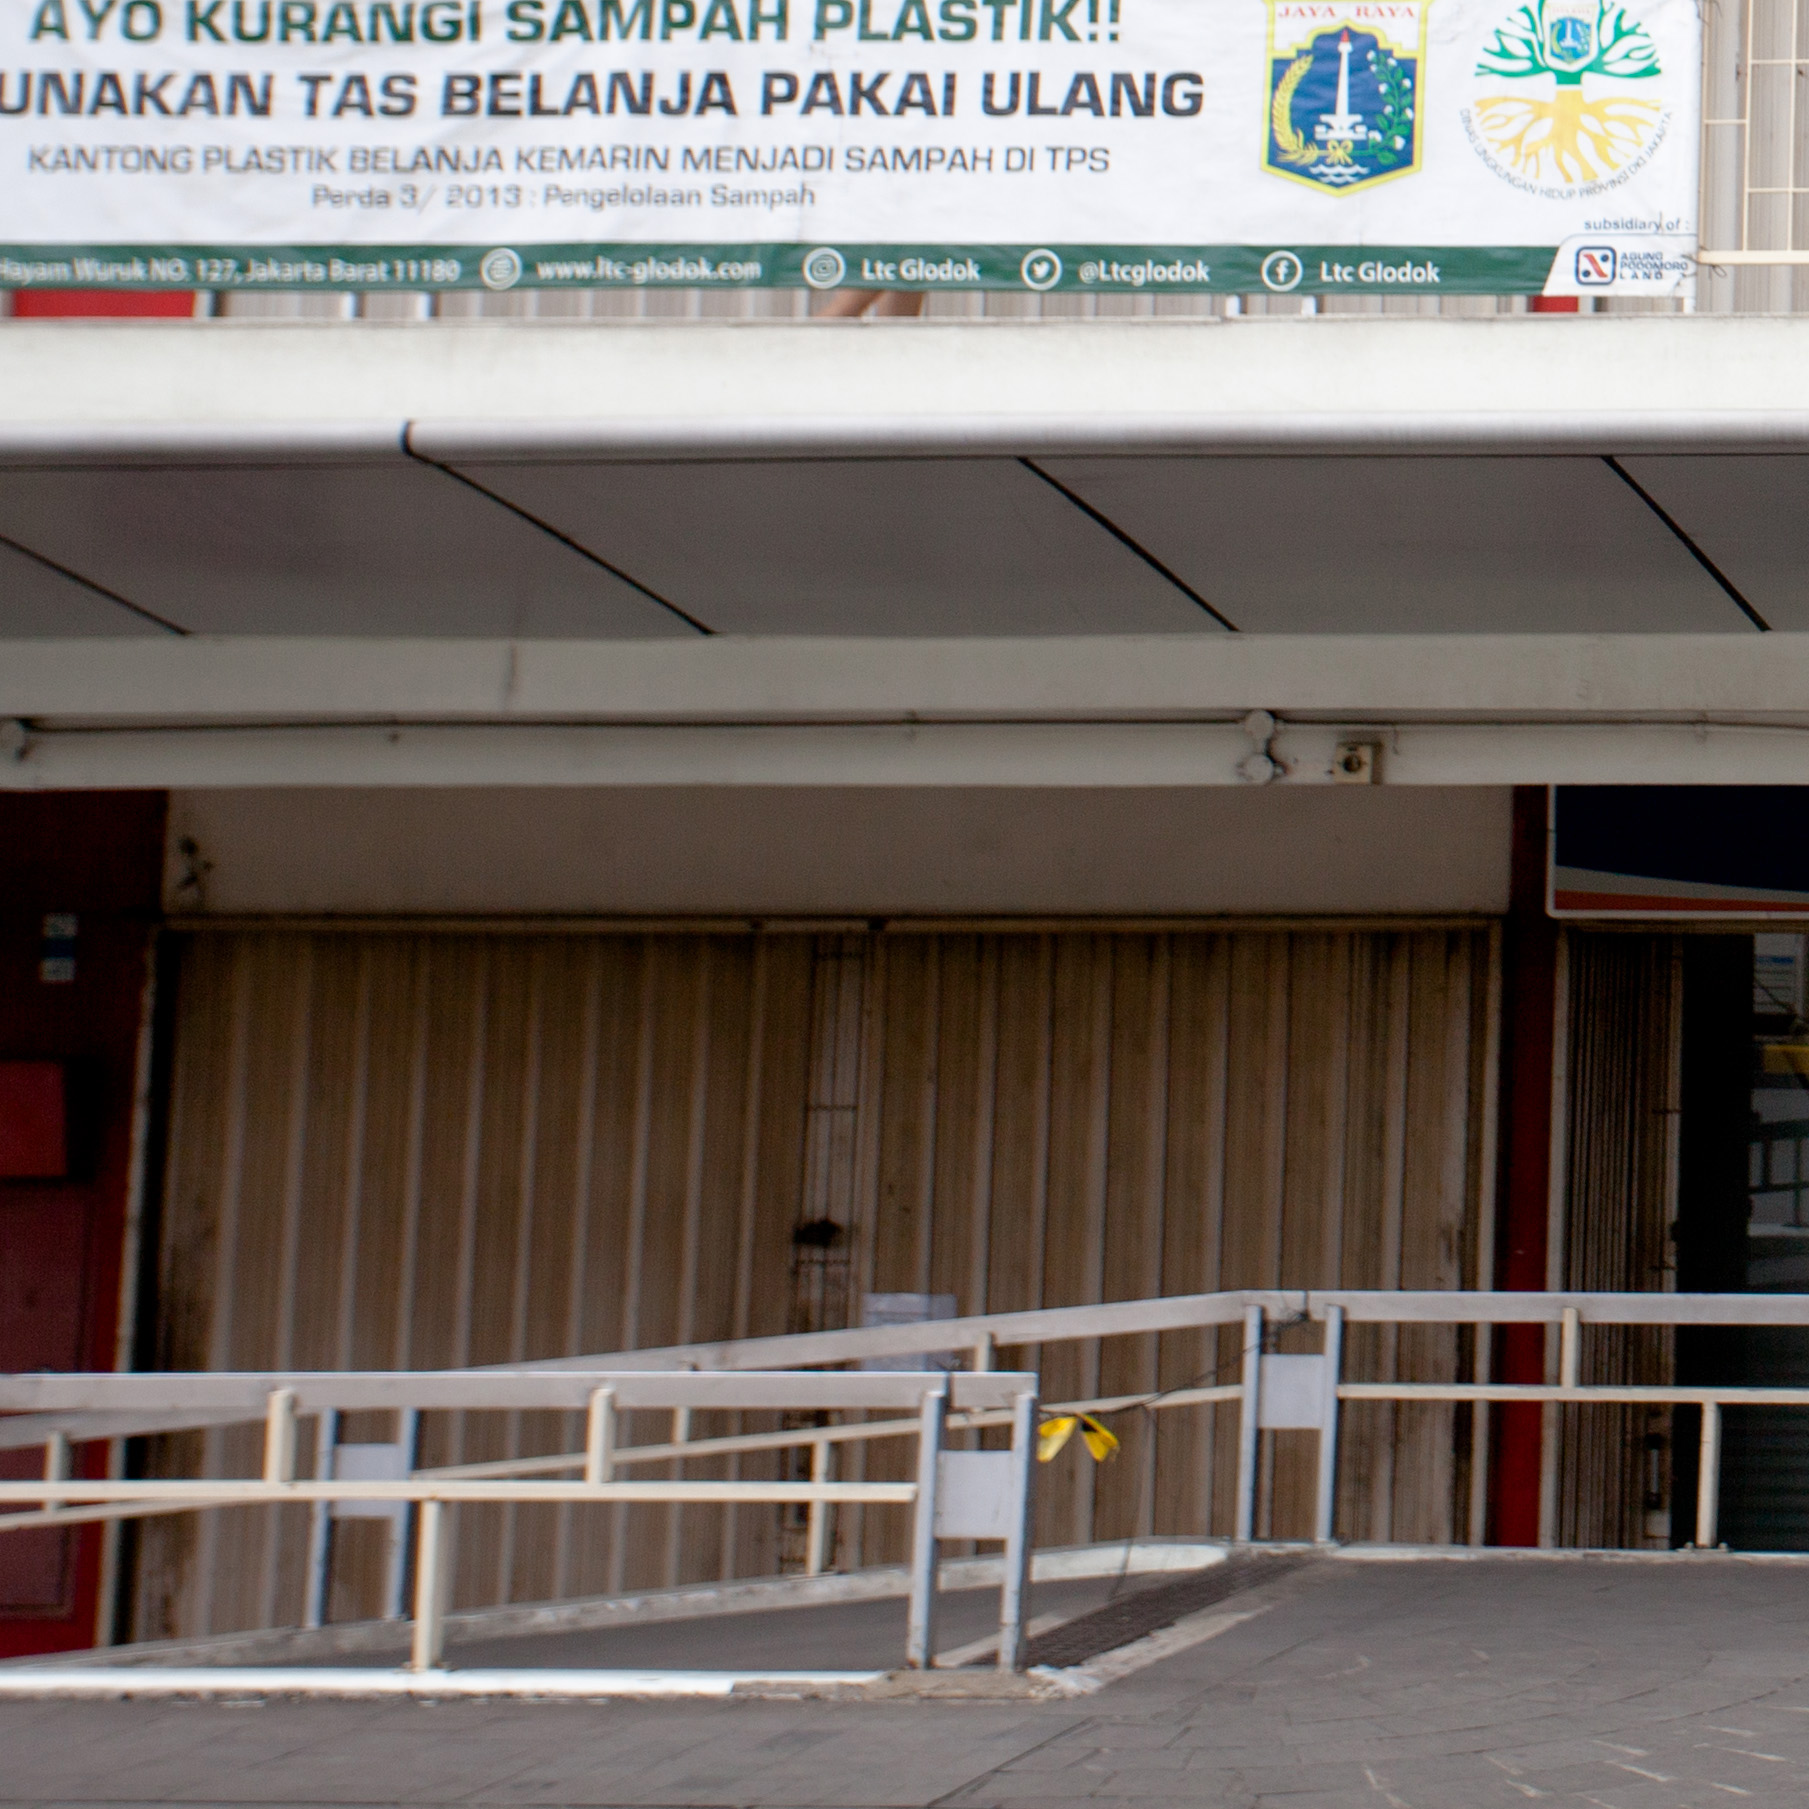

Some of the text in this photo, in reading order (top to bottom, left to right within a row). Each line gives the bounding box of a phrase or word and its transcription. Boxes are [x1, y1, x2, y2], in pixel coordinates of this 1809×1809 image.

[1278, 5, 1415, 18] JAYA RAYA
[0, 71, 1205, 118] UNAKAN TAS BELANJA PAKAI ULANG
[28, 144, 1110, 174] KANTONG PLASTIK BELANJA KEMARIN MENJADI SAMPAH DI TPS
[313, 185, 390, 208] Perda
[446, 185, 521, 208] 2013
[543, 185, 702, 212] Pengelolaan
[711, 185, 815, 211] Sampah
[1539, 186, 1577, 201] HIDUP
[1579, 171, 1630, 199] PROVINSI
[1584, 217, 1661, 235] subsidiary
[1665, 217, 1682, 231] of
[1620, 251, 1664, 261] AGUNG
[1620, 260, 1689, 272] PODOMORO
[72, 257, 147, 282] Wuruk
[246, 257, 327, 282] Jakarta
[330, 258, 390, 282] Barat
[392, 258, 462, 282] 11180
[536, 258, 762, 283] www.ltc-glodok.com
[862, 257, 981, 282] Ltc Glodok
[1079, 259, 1210, 286] @Ltcglodok
[1320, 260, 1441, 284] Ltc Glodok
[1620, 271, 1664, 281] LAND
